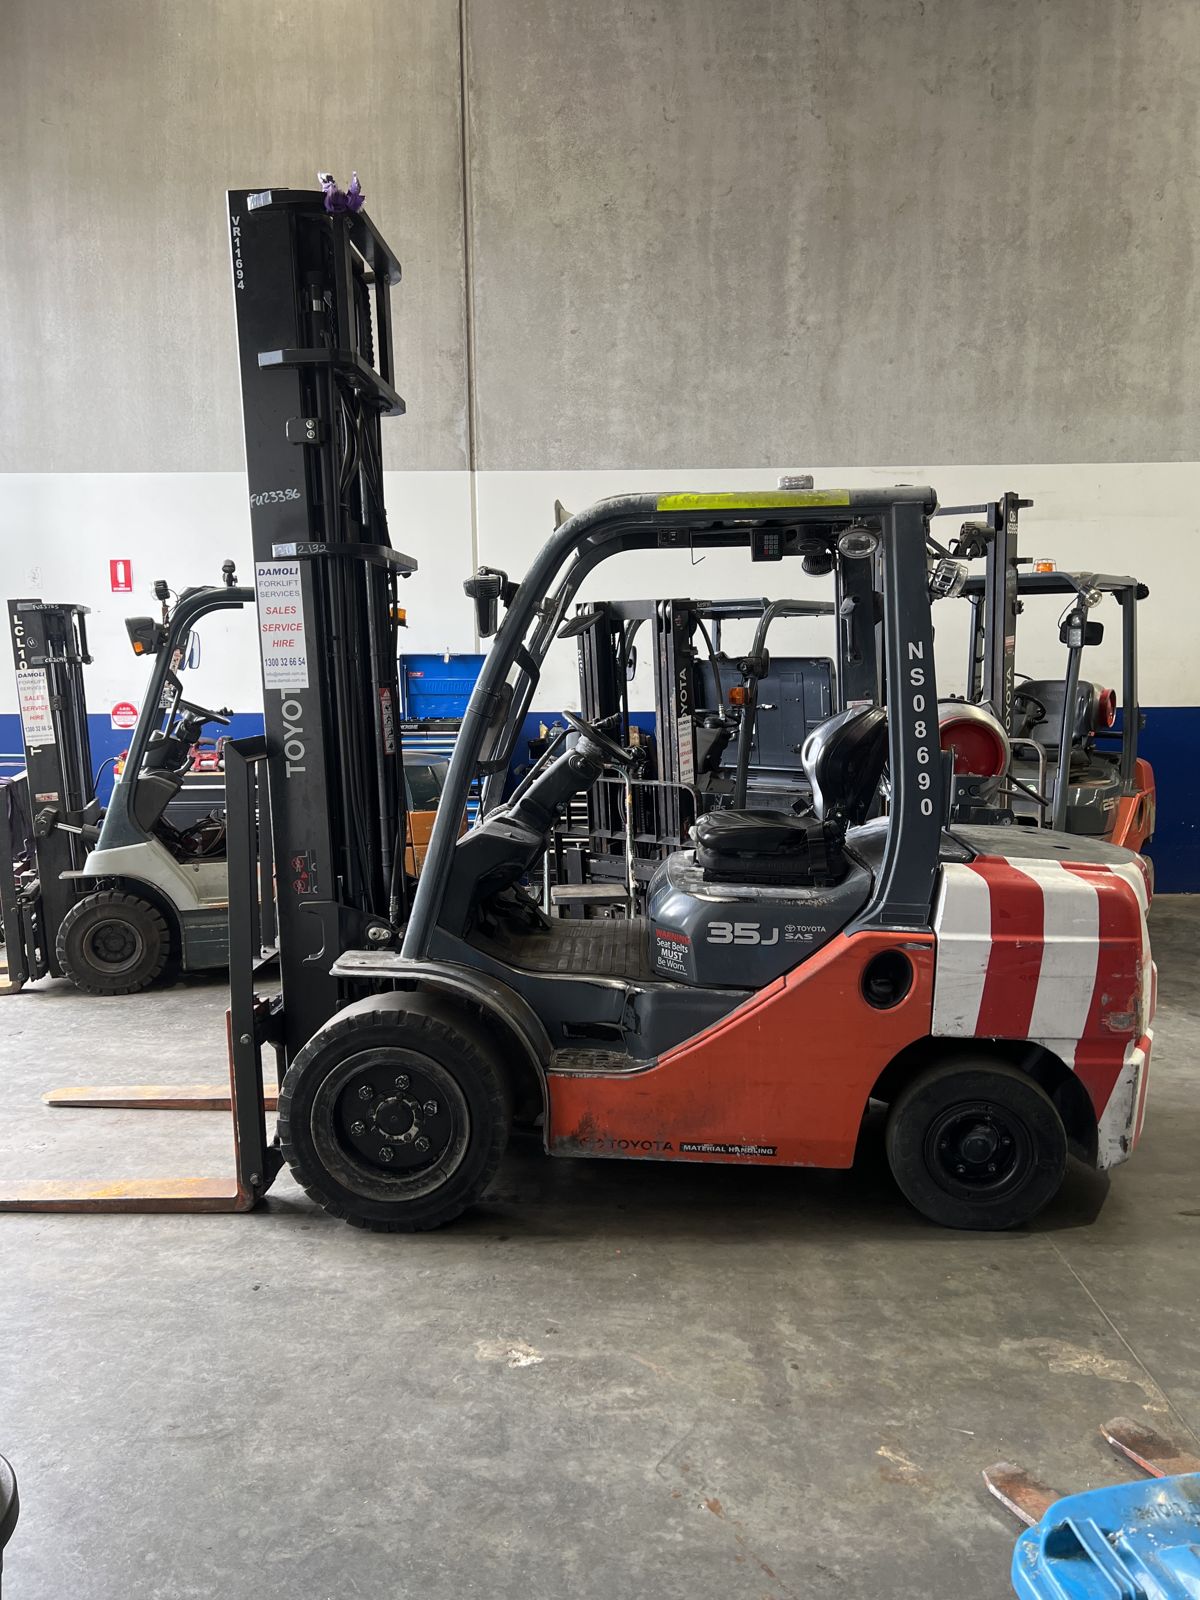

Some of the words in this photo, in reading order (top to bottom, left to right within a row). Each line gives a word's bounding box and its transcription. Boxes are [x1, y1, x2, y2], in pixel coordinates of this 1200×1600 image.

[231, 216, 245, 290] VR11694
[258, 567, 299, 576] DAMOLI
[259, 579, 299, 588] FORKLIFT
[260, 590, 300, 598] SERVICES
[265, 605, 297, 615] SALES
[262, 622, 303, 633] SERVICE
[272, 639, 296, 648] HIRE
[264, 657, 280, 667] 1300
[280, 657, 289, 667] 32
[289, 656, 298, 666] 66
[298, 656, 306, 666] 54
[281, 688, 306, 778] TOYOT
[907, 640, 934, 817] NS08690
[707, 921, 779, 946] 35J
[797, 925, 827, 933] TOYOTA
[656, 937, 671, 949] Seat
[672, 941, 689, 954] Belts
[661, 948, 683, 961] MUST
[657, 956, 666, 966] Be
[611, 1139, 673, 1151] TOYOTA
[683, 1144, 726, 1153] MATERIAL
[728, 1146, 774, 1155] HANDLING
